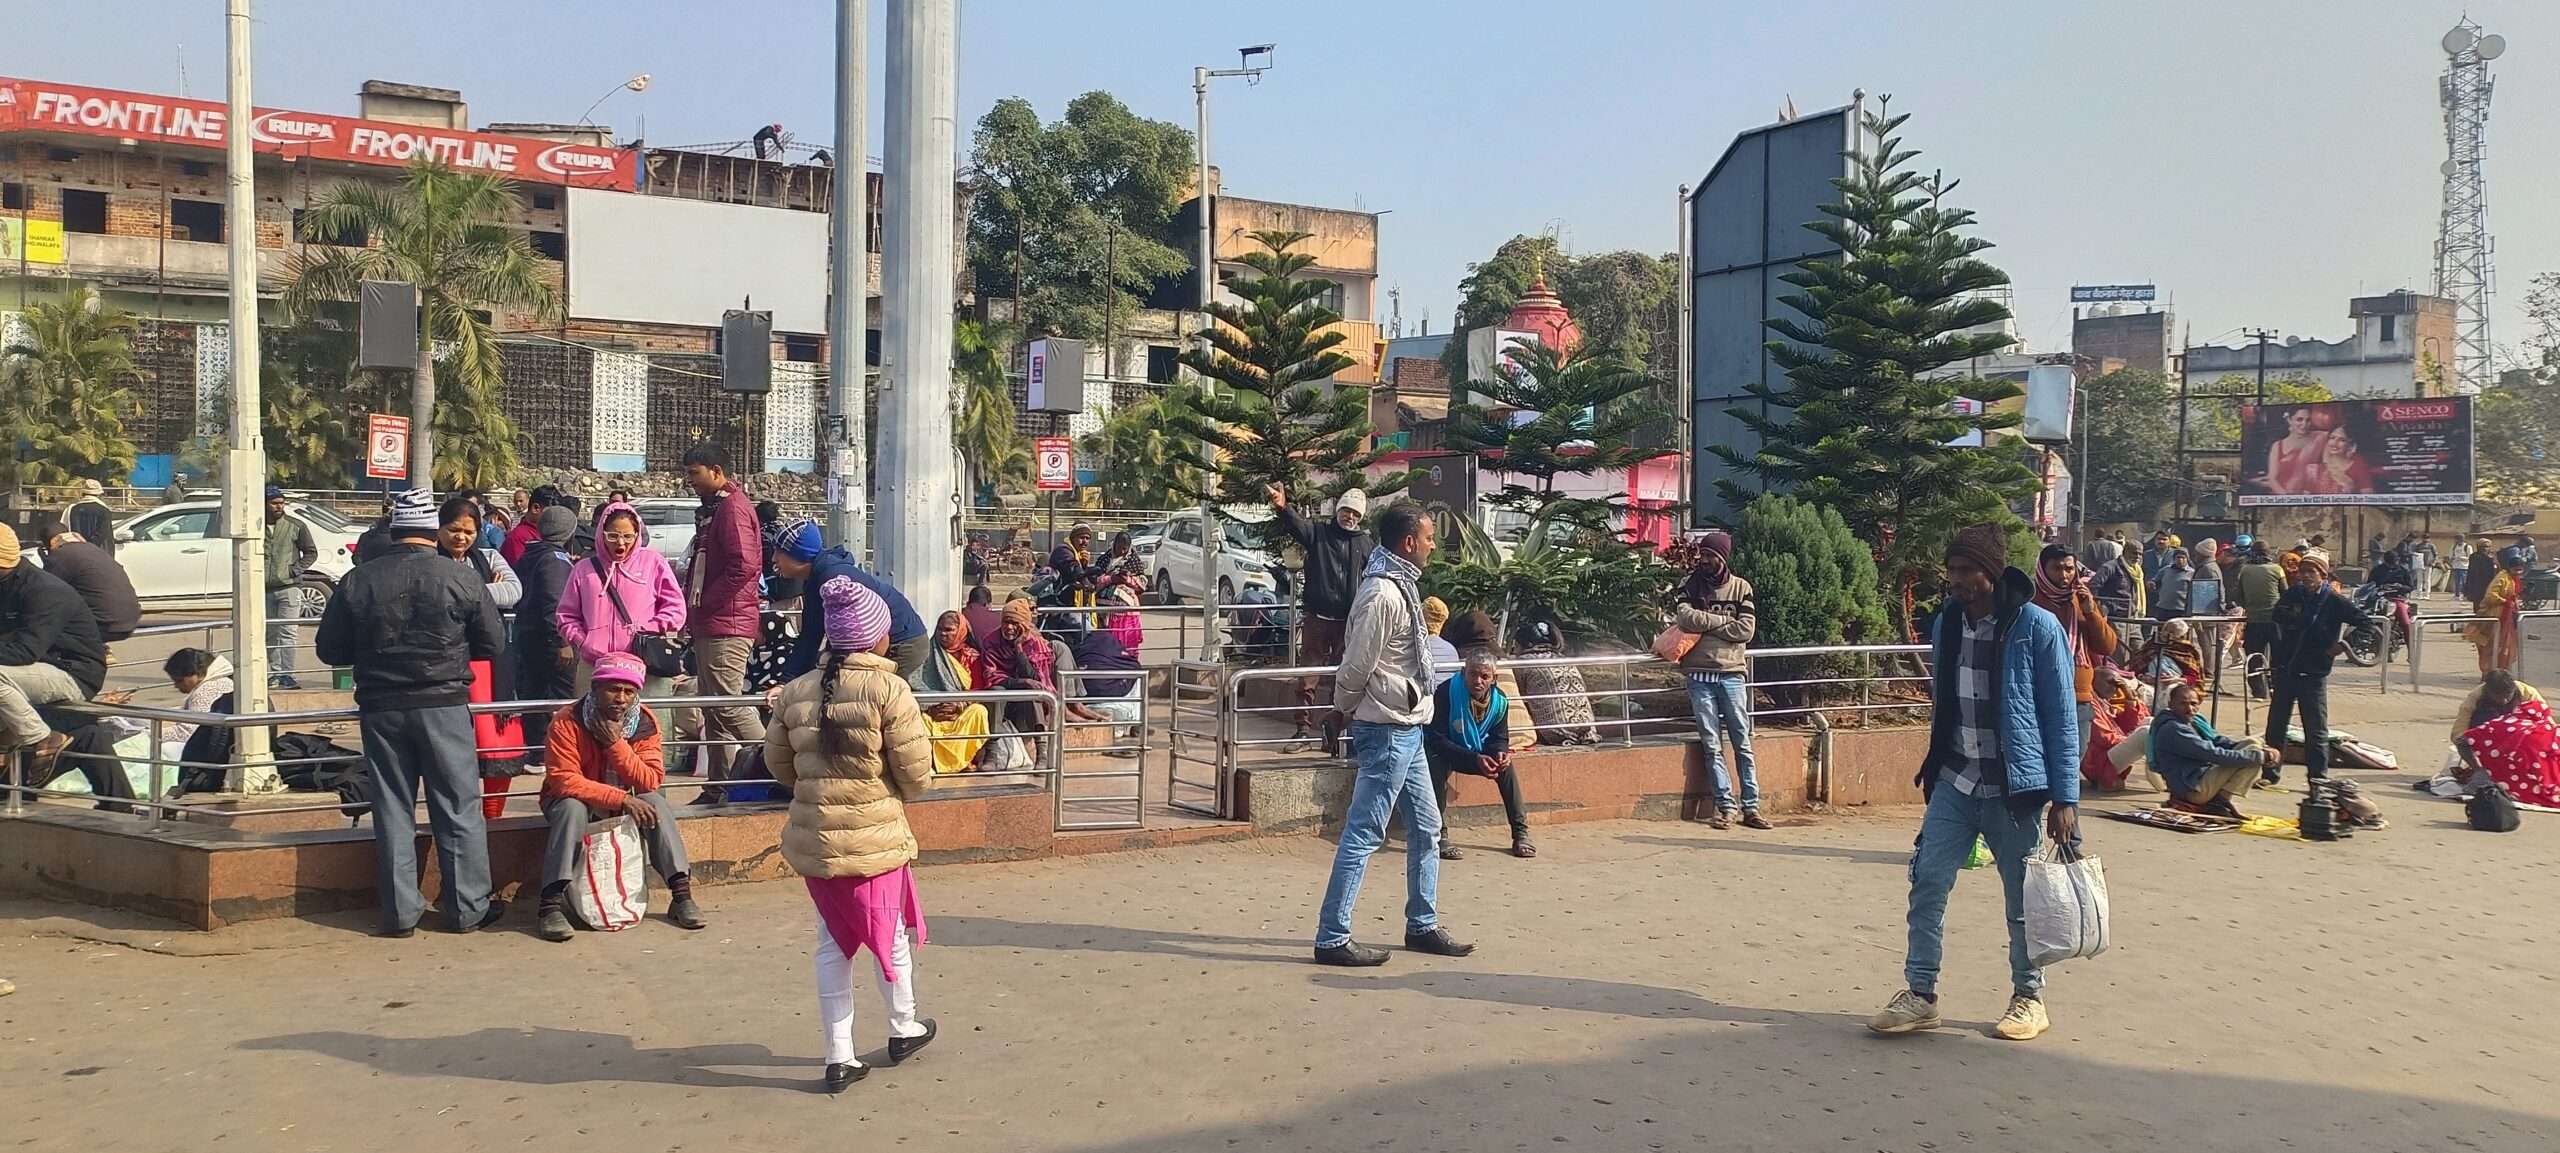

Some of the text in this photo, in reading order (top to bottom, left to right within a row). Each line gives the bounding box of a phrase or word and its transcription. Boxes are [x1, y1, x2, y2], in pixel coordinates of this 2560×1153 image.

[33, 91, 227, 141] FRONTLINE
[268, 118, 336, 139] RUPA
[349, 127, 519, 172] FRONTLINE
[556, 151, 616, 170] RUPA
[2395, 404, 2449, 415] SENCO
